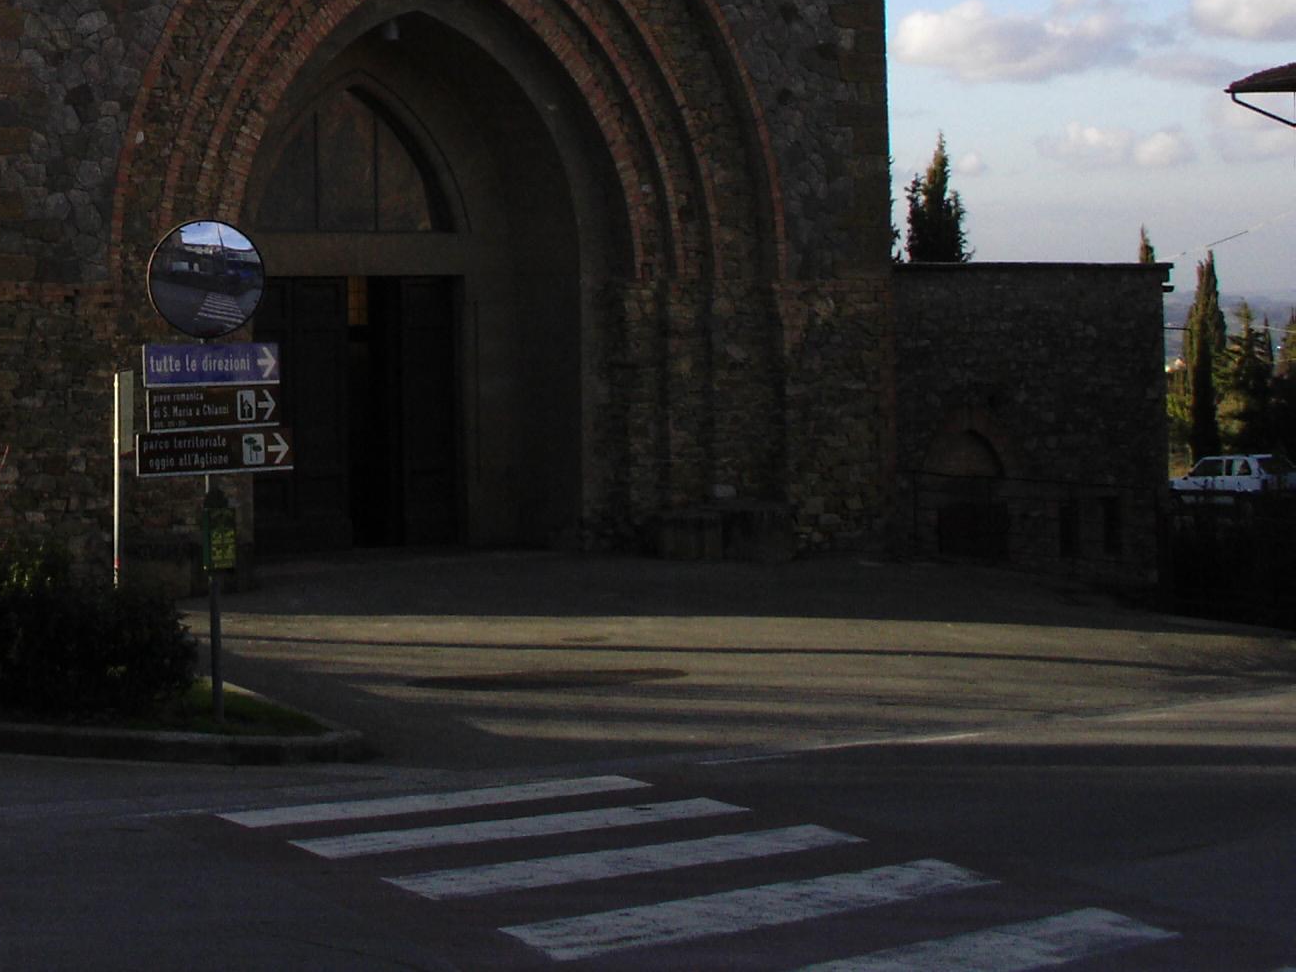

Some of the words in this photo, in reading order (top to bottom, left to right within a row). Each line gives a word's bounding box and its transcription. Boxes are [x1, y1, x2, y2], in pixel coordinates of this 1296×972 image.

[150, 355, 181, 372] tutte
[186, 354, 197, 372] le
[202, 354, 251, 371] direzioni
[173, 405, 193, 417] Maria
[195, 407, 201, 416] a
[143, 440, 170, 452] parco
[174, 435, 227, 449] territoriale
